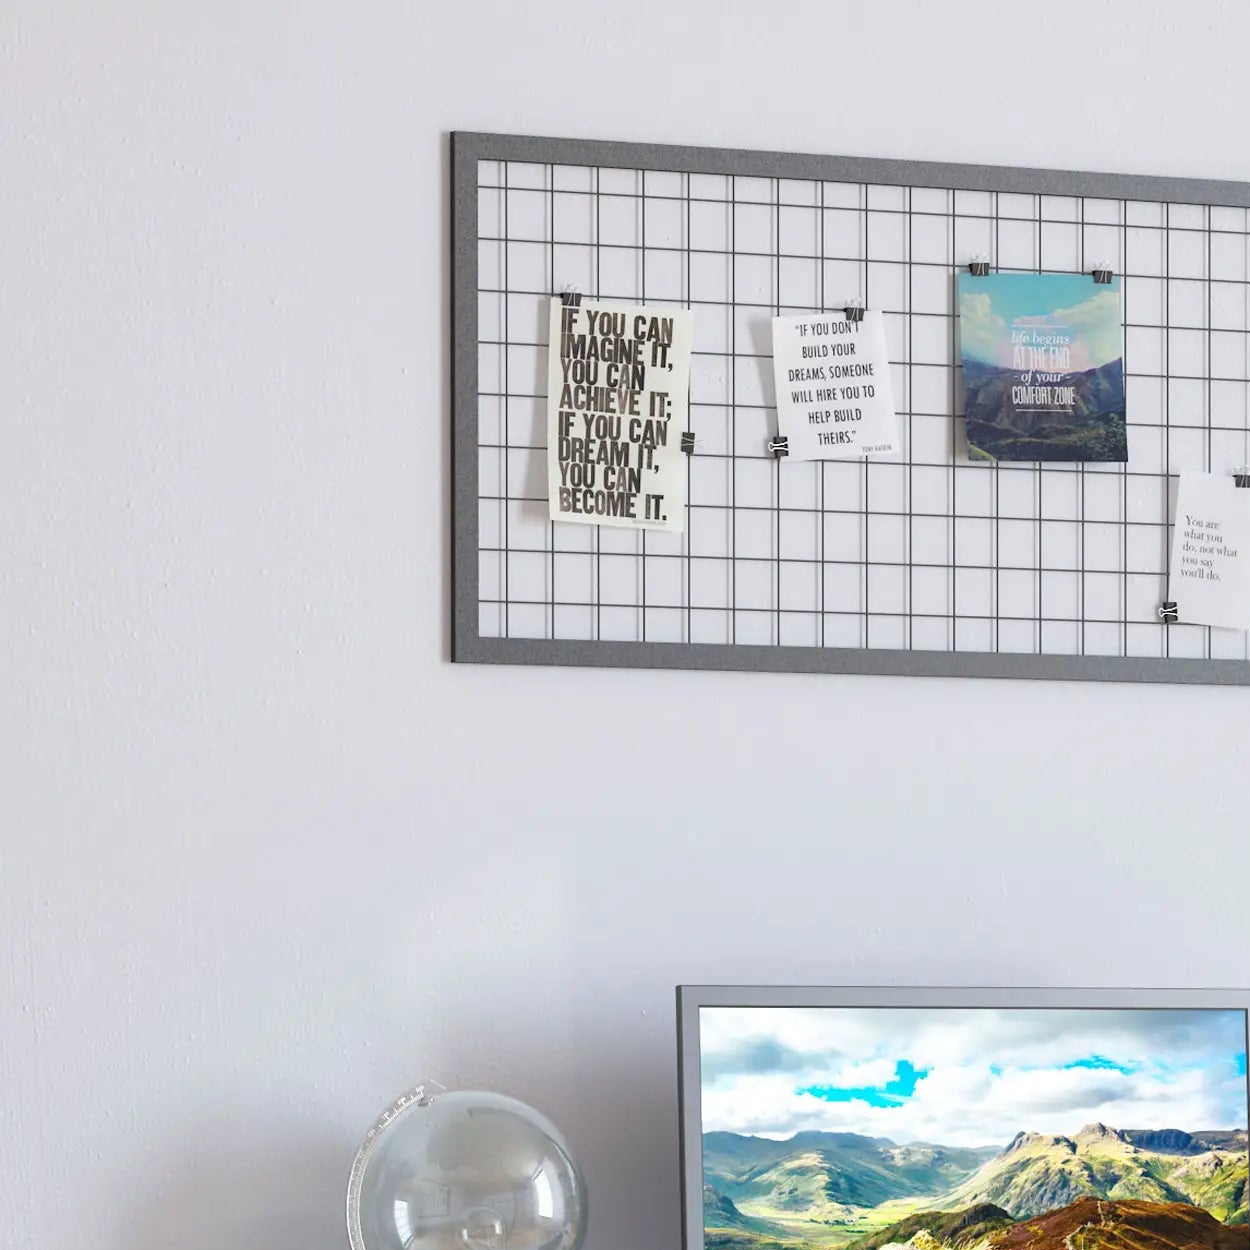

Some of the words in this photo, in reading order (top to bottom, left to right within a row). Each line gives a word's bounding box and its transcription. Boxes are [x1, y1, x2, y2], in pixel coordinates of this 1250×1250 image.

[561, 308, 578, 334] IF
[587, 310, 626, 336] YOU
[633, 315, 673, 343] CAN
[811, 322, 829, 336] YOU
[1011, 330, 1029, 346] life
[1032, 330, 1069, 347] begins
[560, 333, 644, 365] IMAGINE
[650, 342, 673, 372] IT,
[802, 344, 829, 359] BUILD
[831, 343, 856, 357] YOUR
[1013, 347, 1027, 369] AT
[1028, 347, 1049, 369] THE
[1049, 348, 1070, 370] END
[560, 359, 599, 386] YOU
[606, 363, 645, 391] CAN
[788, 367, 827, 382] DREAMS,
[829, 363, 875, 379] SOMEONE
[1021, 370, 1034, 386] of
[1036, 372, 1064, 387] your
[559, 384, 641, 416] ACHIEVE
[650, 391, 672, 422] IT;
[791, 390, 814, 404] WILL
[816, 388, 838, 402] HIRE
[840, 386, 860, 400] YOU
[862, 385, 875, 398] TO
[1012, 386, 1052, 405] COMFORT
[1054, 387, 1076, 406] ZONE
[808, 410, 831, 424] HELP
[834, 408, 862, 423] BUILD
[558, 411, 576, 437] IF
[583, 414, 621, 441] YOU
[629, 419, 668, 446] CAN
[557, 437, 630, 467] DREAM
[637, 444, 660, 474] IT,
[559, 462, 595, 488] YOU
[603, 466, 642, 493] CAN
[559, 487, 637, 518] BECOME
[645, 493, 668, 520] IT.
[1185, 515, 1203, 529] You
[1205, 521, 1221, 530] are
[1183, 529, 1204, 541] what
[1206, 533, 1223, 545] you
[1182, 541, 1198, 553] do,
[1199, 545, 1214, 555] not
[1216, 545, 1238, 558] what
[1181, 556, 1199, 567] you
[1200, 557, 1214, 569] say
[1180, 567, 1205, 580] you'll
[1206, 569, 1222, 582] do.
